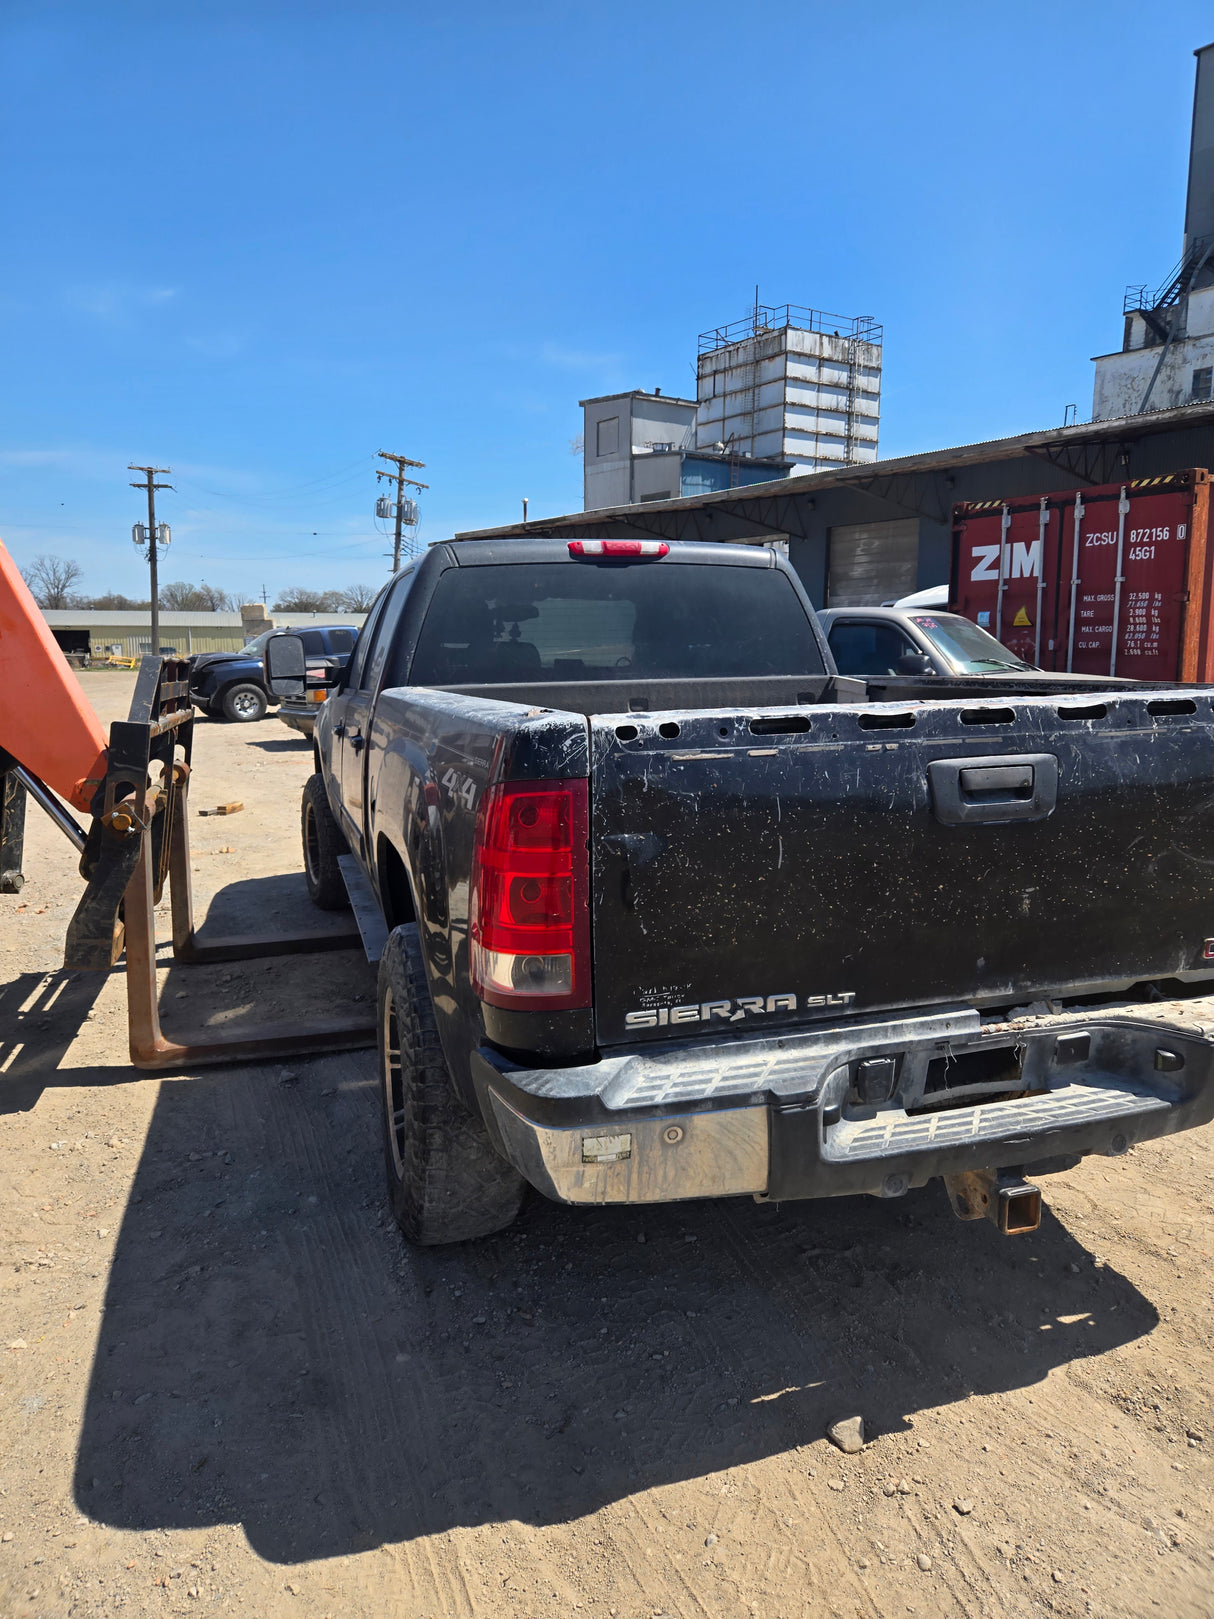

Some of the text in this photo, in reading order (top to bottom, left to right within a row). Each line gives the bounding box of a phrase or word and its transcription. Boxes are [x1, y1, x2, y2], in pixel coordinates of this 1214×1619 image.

[1085, 531, 1117, 547] ZCSU
[1130, 527, 1170, 543] 872156
[1129, 546, 1155, 560] 45G1
[971, 540, 1041, 582] ZIM
[1154, 592, 1162, 600] kg
[1080, 610, 1094, 618] TARE
[1095, 625, 1113, 633] CARGO
[1152, 625, 1159, 633] kg
[625, 992, 856, 1030] SIERRA SLT
